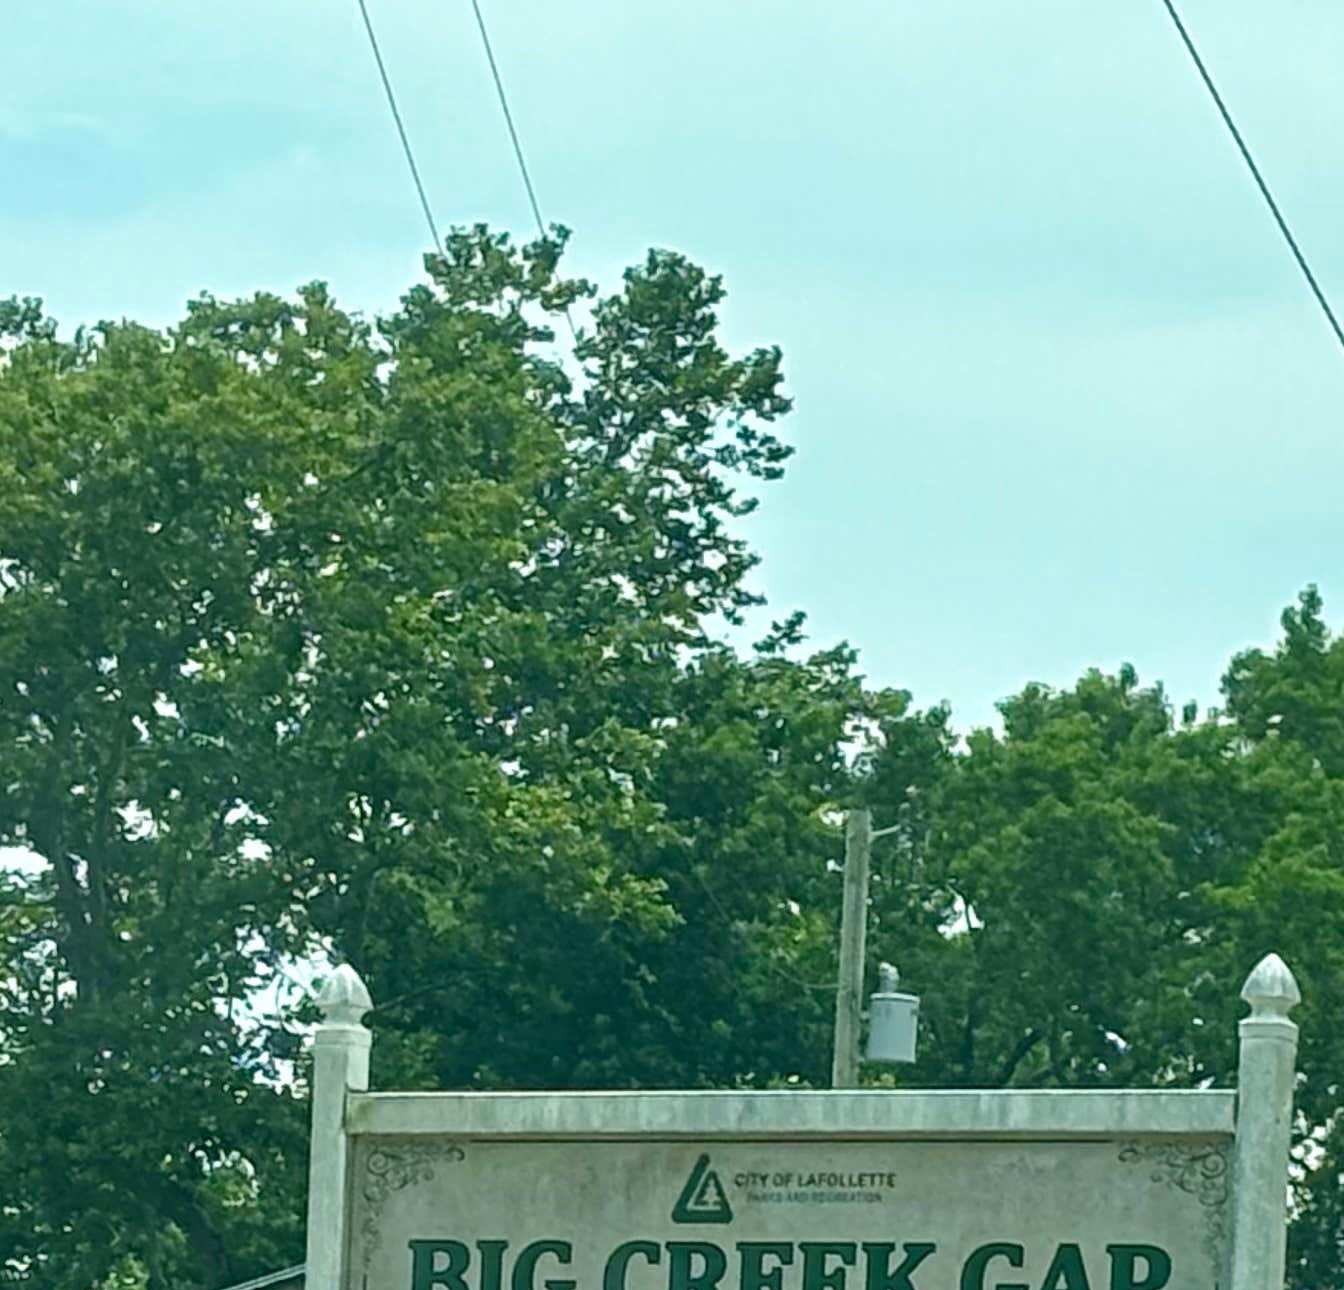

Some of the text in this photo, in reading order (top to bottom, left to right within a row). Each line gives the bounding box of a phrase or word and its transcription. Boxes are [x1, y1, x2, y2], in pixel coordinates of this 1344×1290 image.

[734, 1171, 897, 1189] CITY OF LAFOLLETTE
